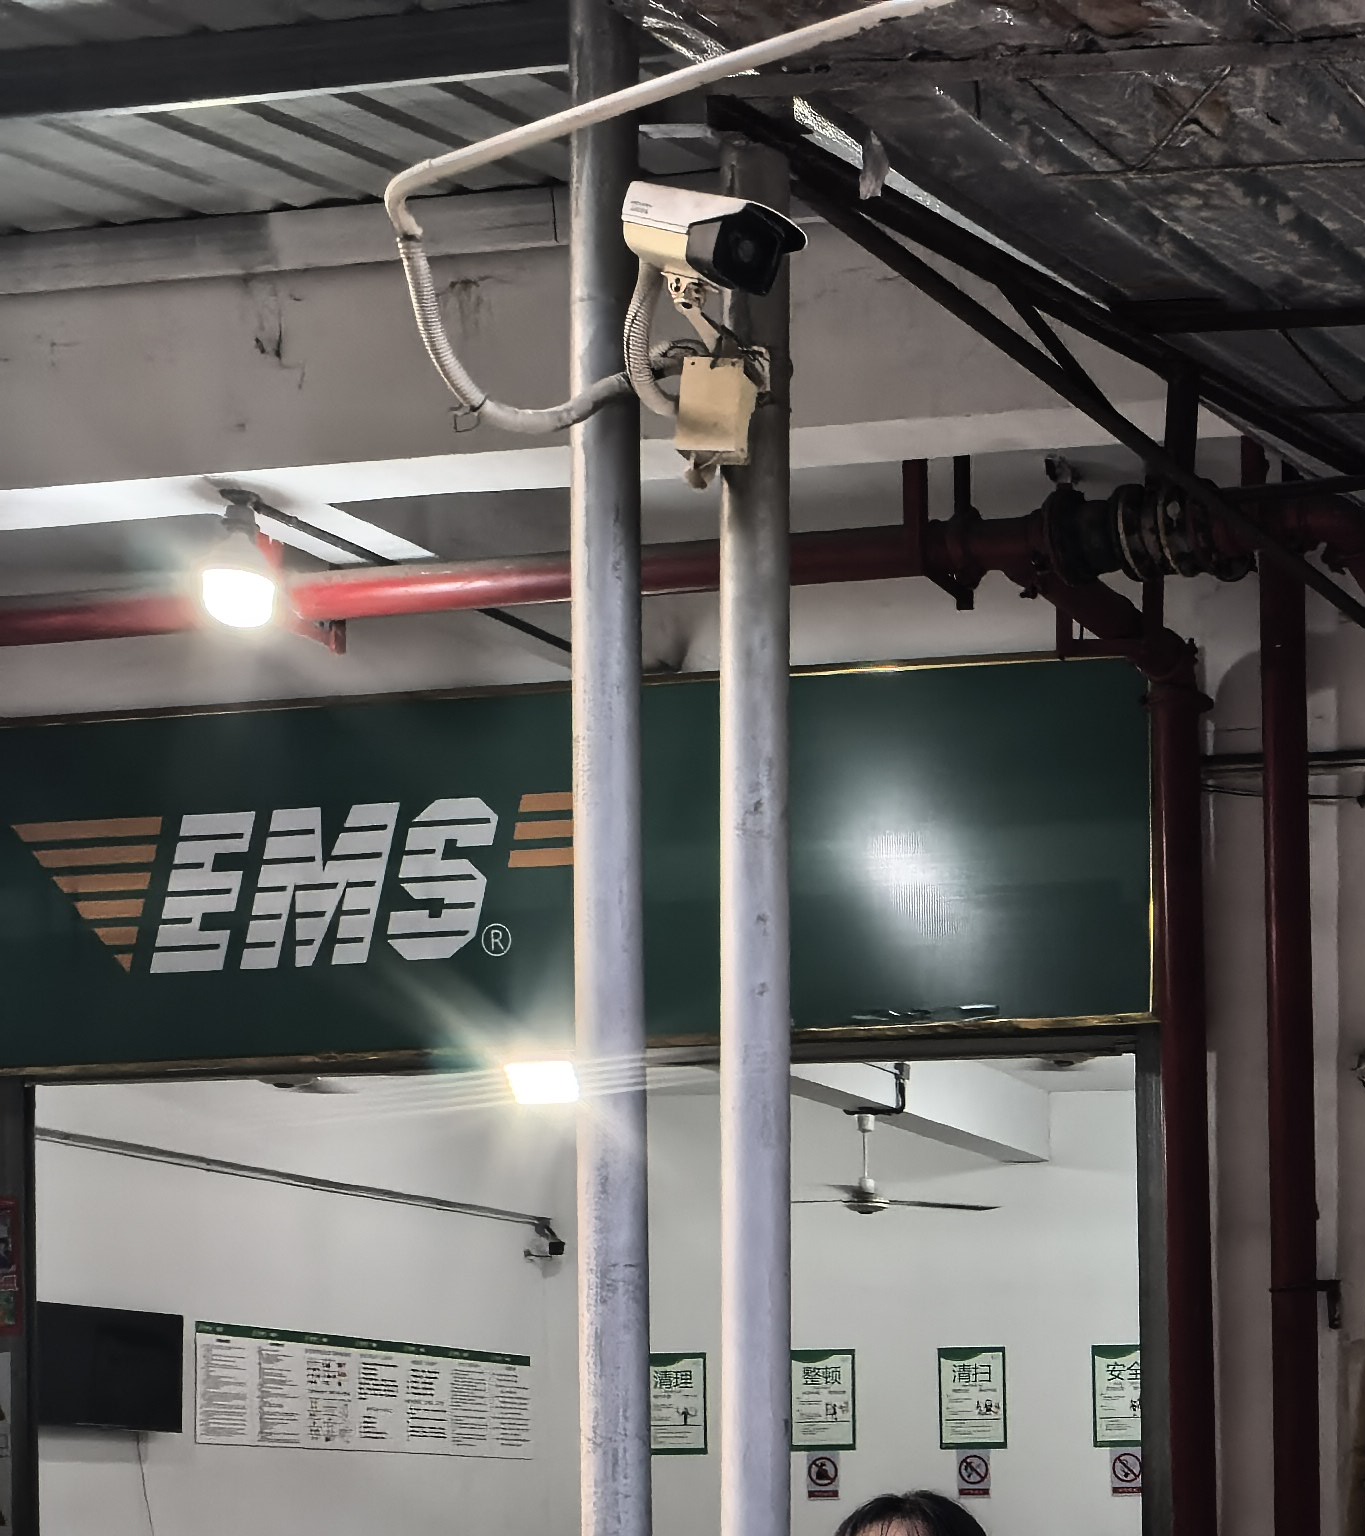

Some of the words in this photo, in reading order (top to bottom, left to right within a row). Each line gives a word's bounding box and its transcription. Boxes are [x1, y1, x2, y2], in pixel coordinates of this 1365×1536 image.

[150, 798, 498, 973] EMS
[802, 1366, 841, 1386] 整顿
[952, 1363, 991, 1384] 清扫
[1106, 1361, 1141, 1382] 安全
